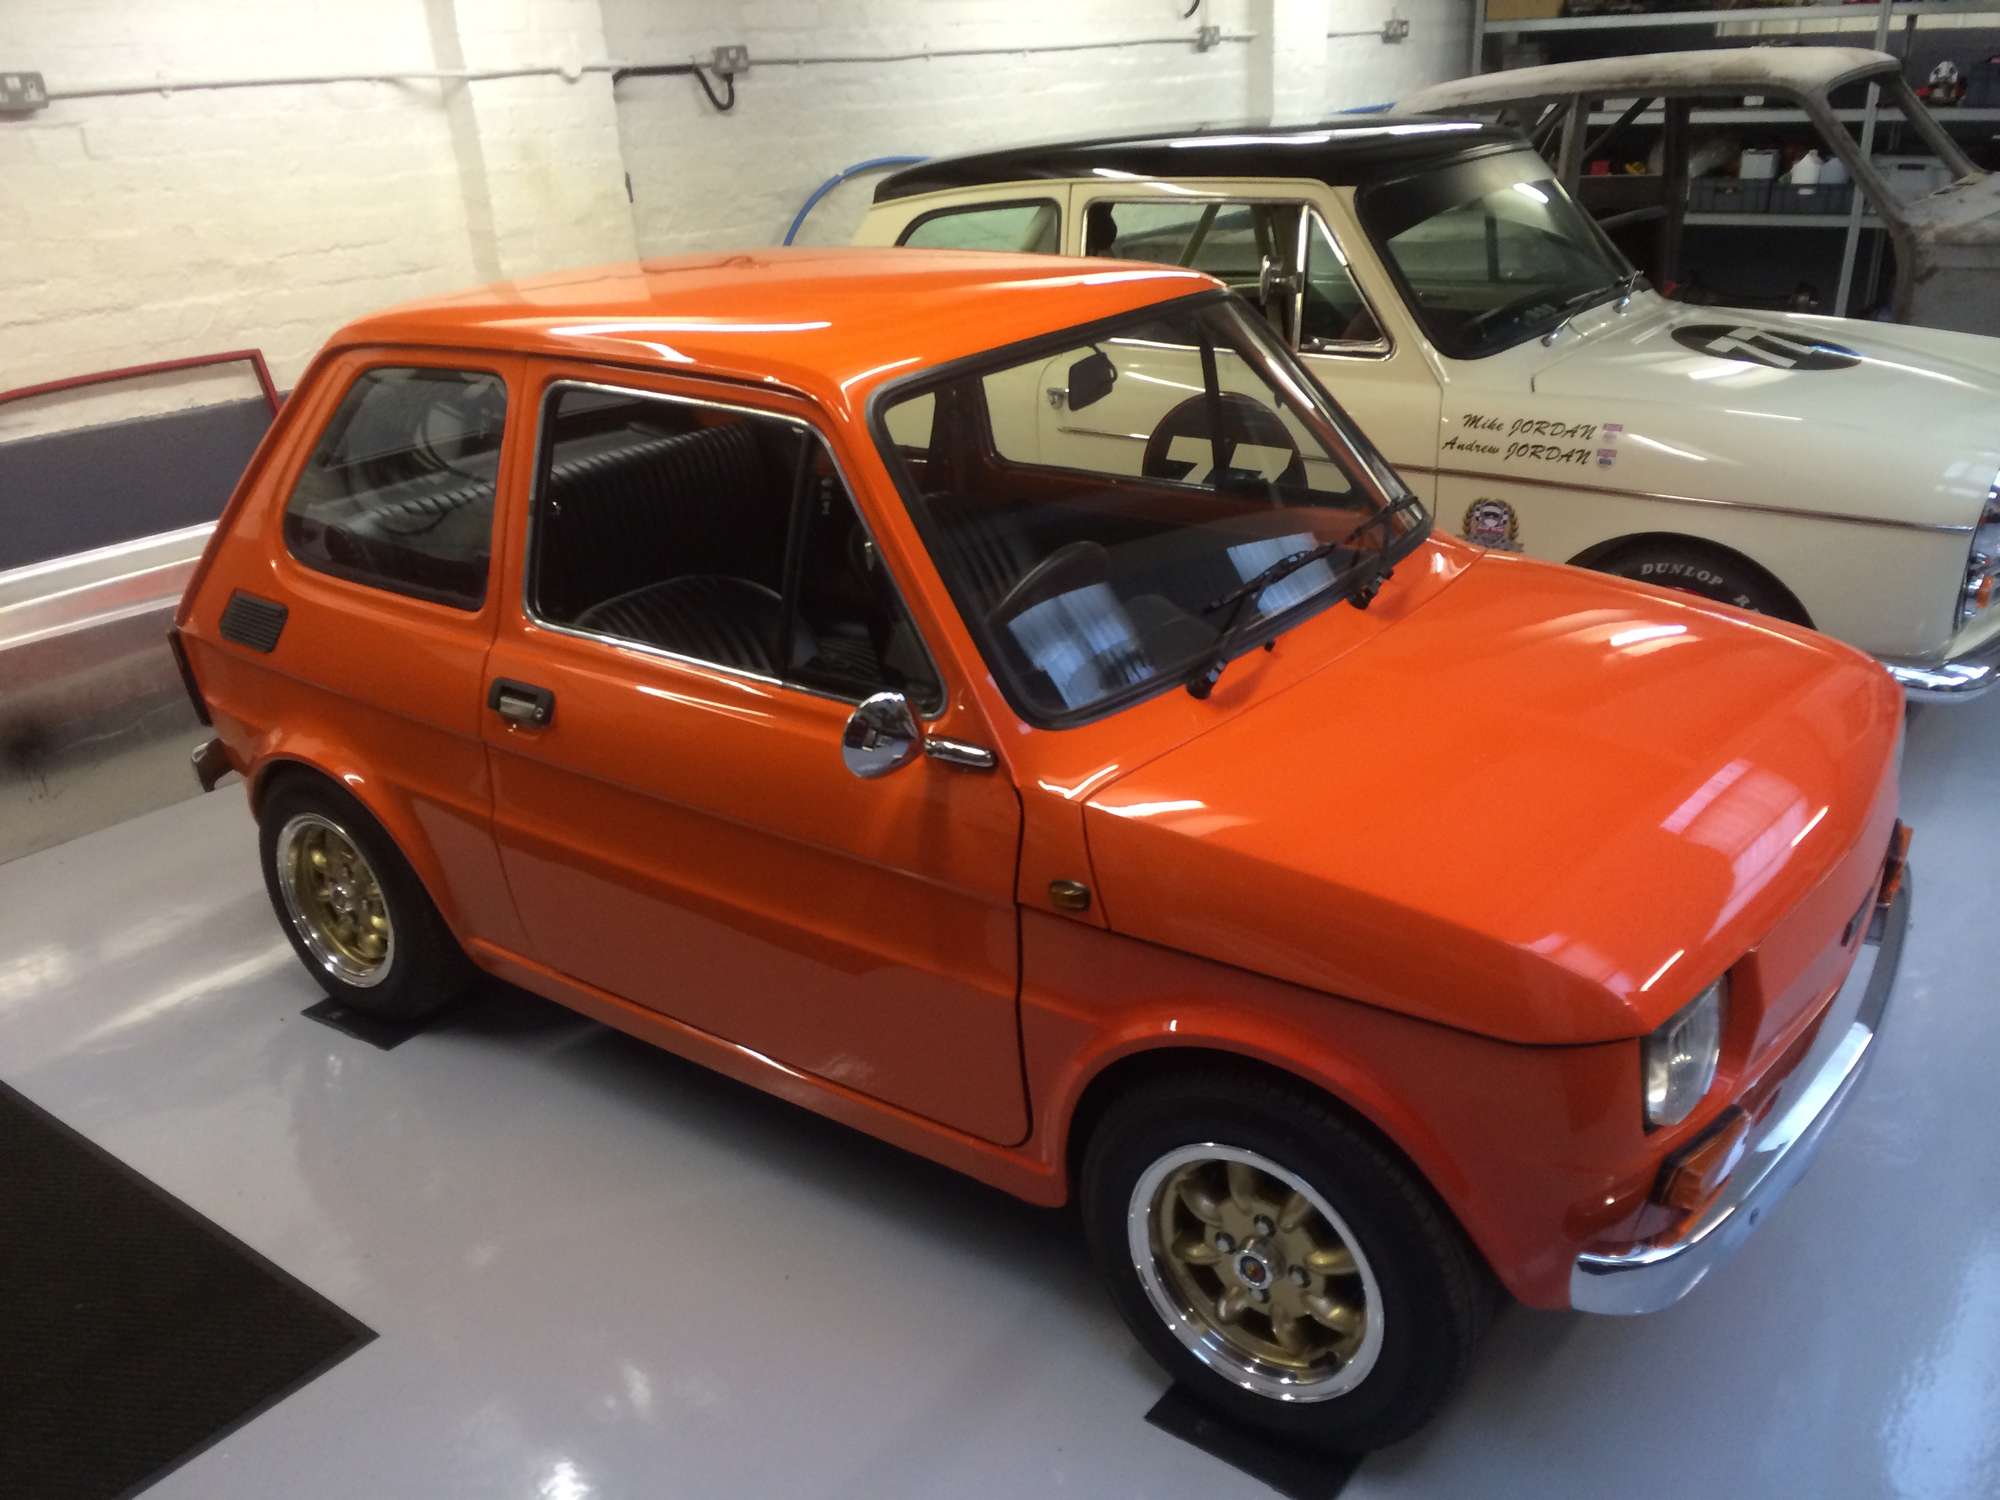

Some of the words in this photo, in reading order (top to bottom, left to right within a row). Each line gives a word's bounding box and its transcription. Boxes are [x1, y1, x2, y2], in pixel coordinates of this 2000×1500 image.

[1705, 326, 1817, 368] 77
[1463, 413, 1504, 431] Mike
[1508, 418, 1598, 440] JORDAN
[1442, 436, 1500, 455] Andrew
[1504, 442, 1592, 465] JORDAN
[1641, 562, 1724, 586] DUNLOP
